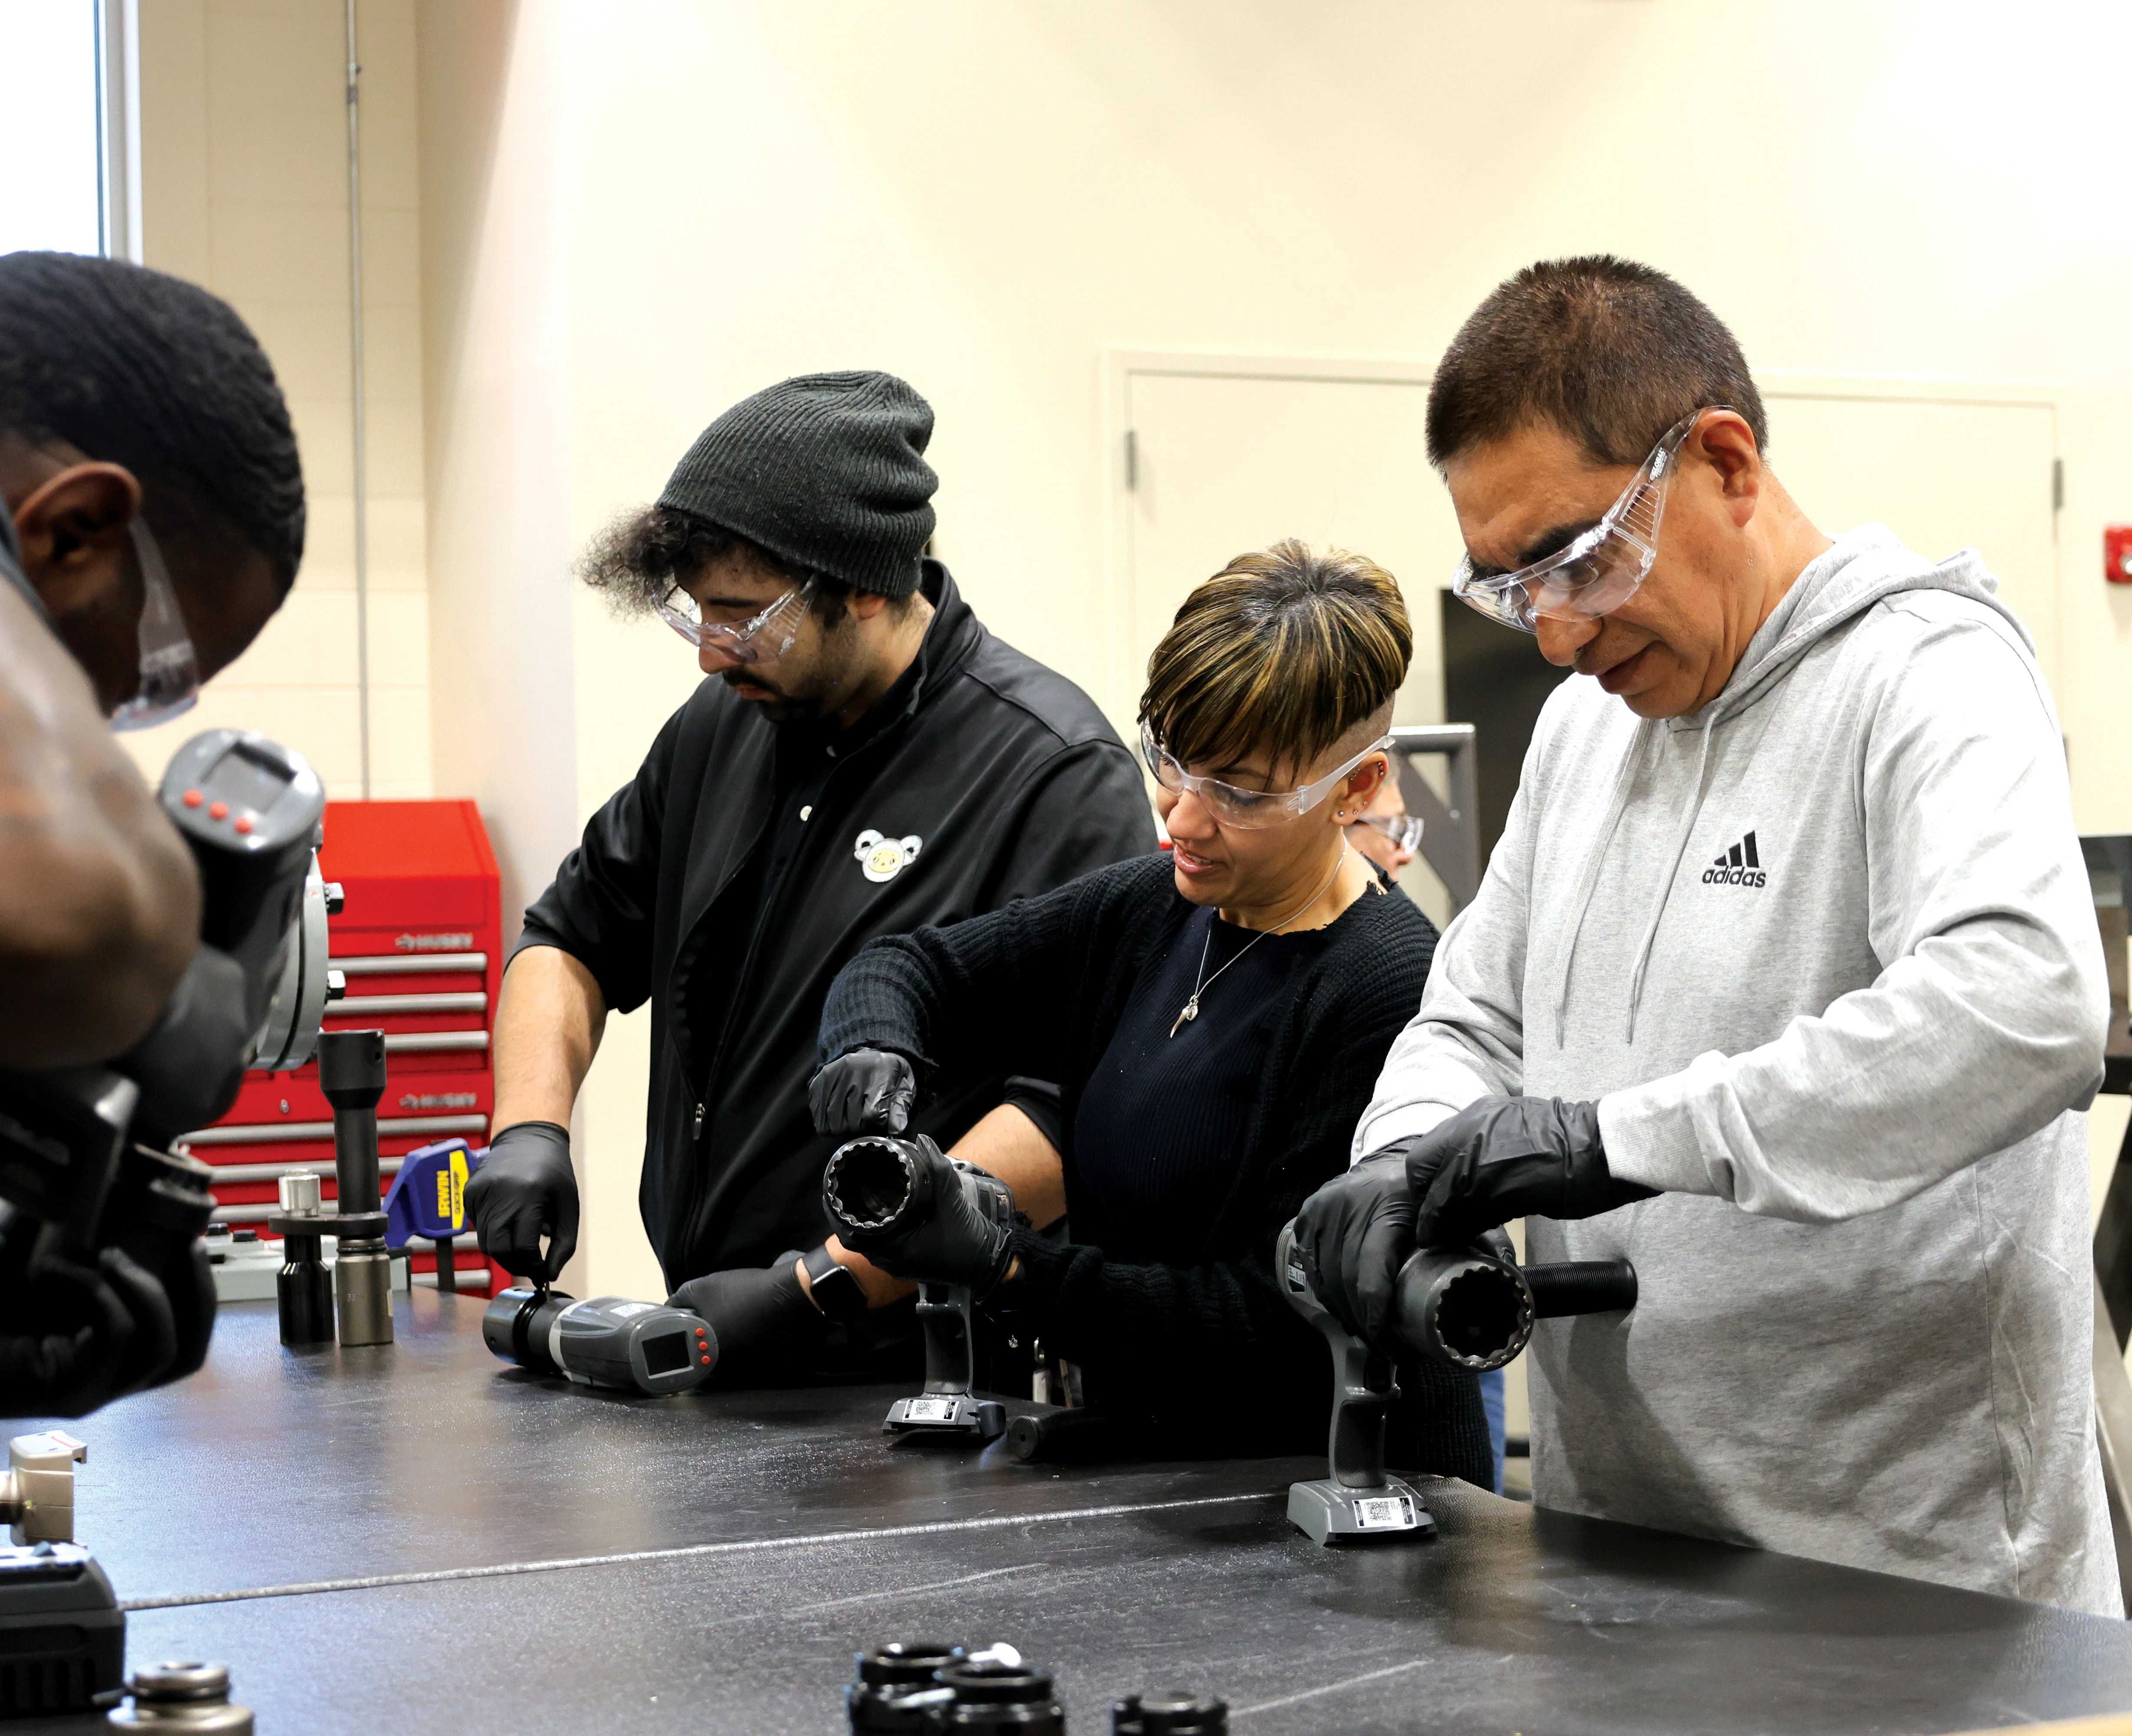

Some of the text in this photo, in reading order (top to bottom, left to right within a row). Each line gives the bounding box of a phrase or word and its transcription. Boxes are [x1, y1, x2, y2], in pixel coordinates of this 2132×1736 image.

[1652, 450, 1665, 476] GLOBAL
[1702, 865, 1766, 888] adidas
[416, 933, 473, 950] HUSKY
[437, 1170, 450, 1218] IRWIN
